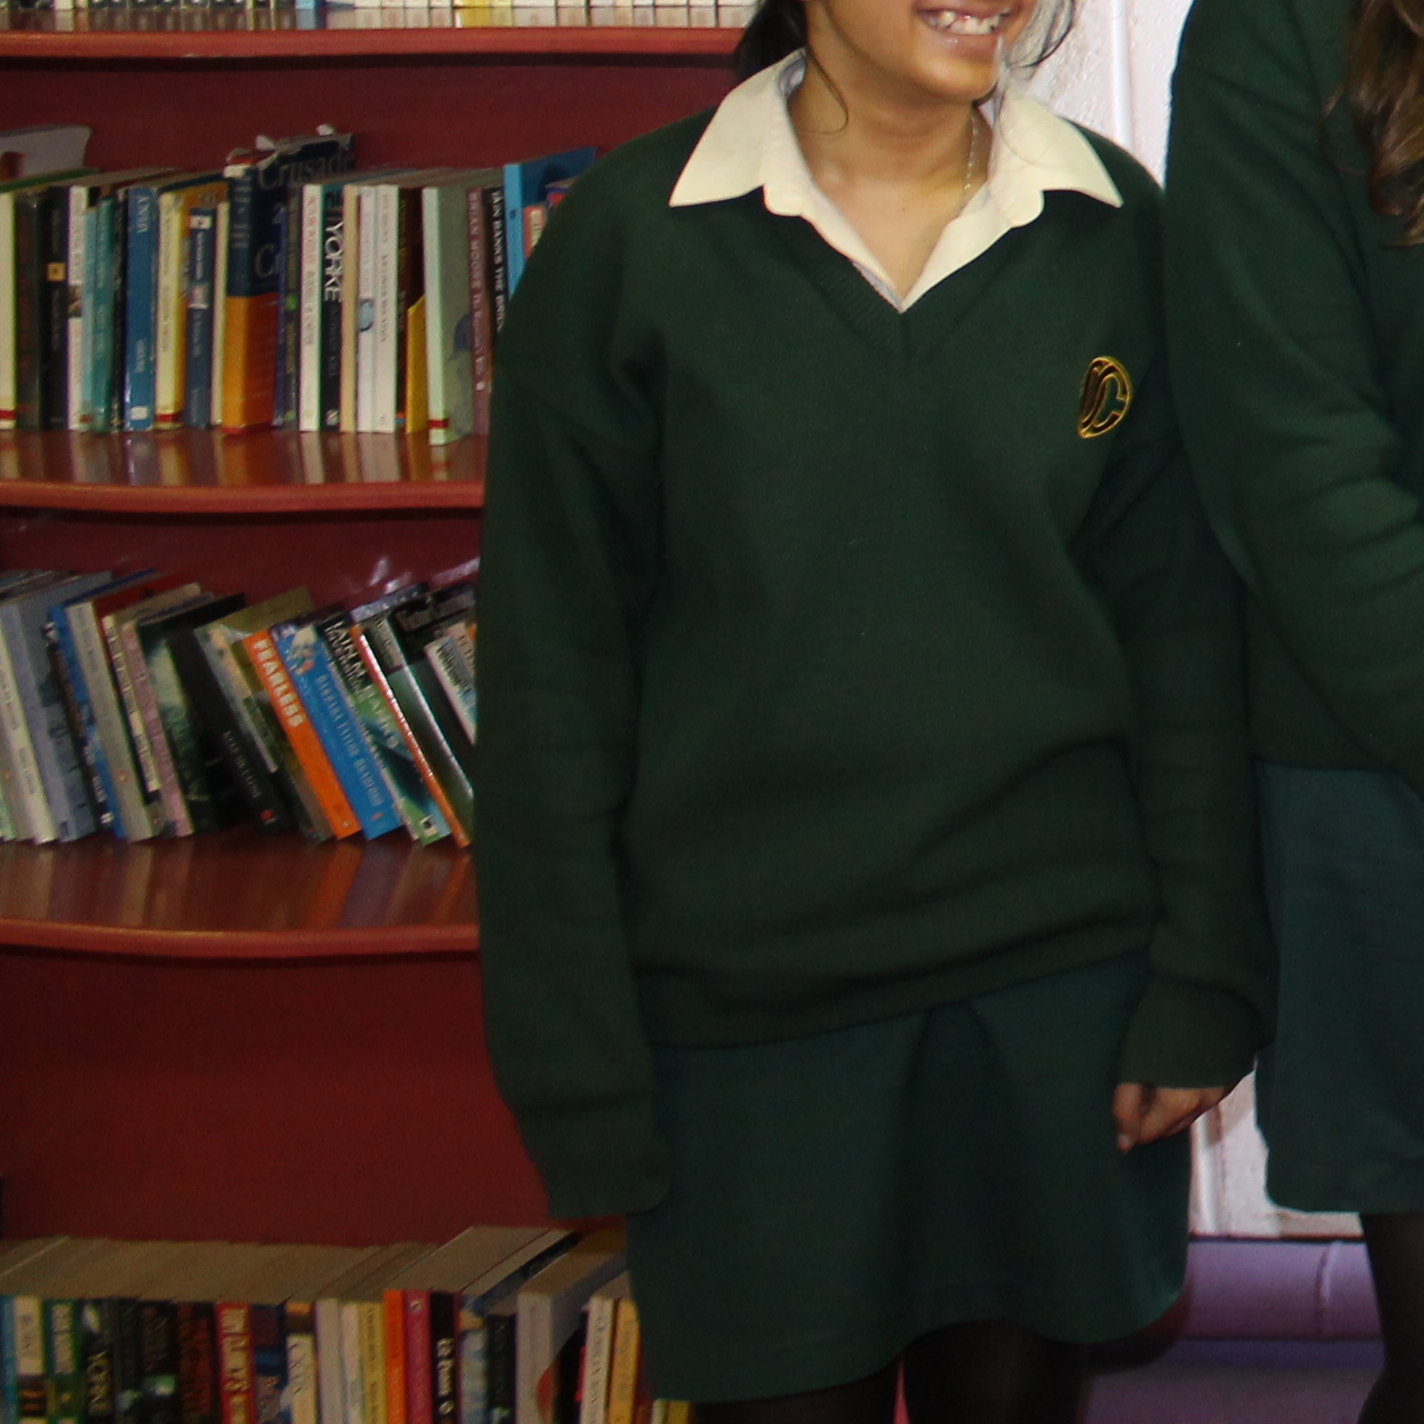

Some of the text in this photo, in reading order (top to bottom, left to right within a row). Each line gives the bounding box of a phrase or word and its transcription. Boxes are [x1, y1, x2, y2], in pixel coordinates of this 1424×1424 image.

[323, 220, 345, 304] YORKE
[469, 239, 482, 290] MOORE
[252, 636, 306, 728] FEARLESS
